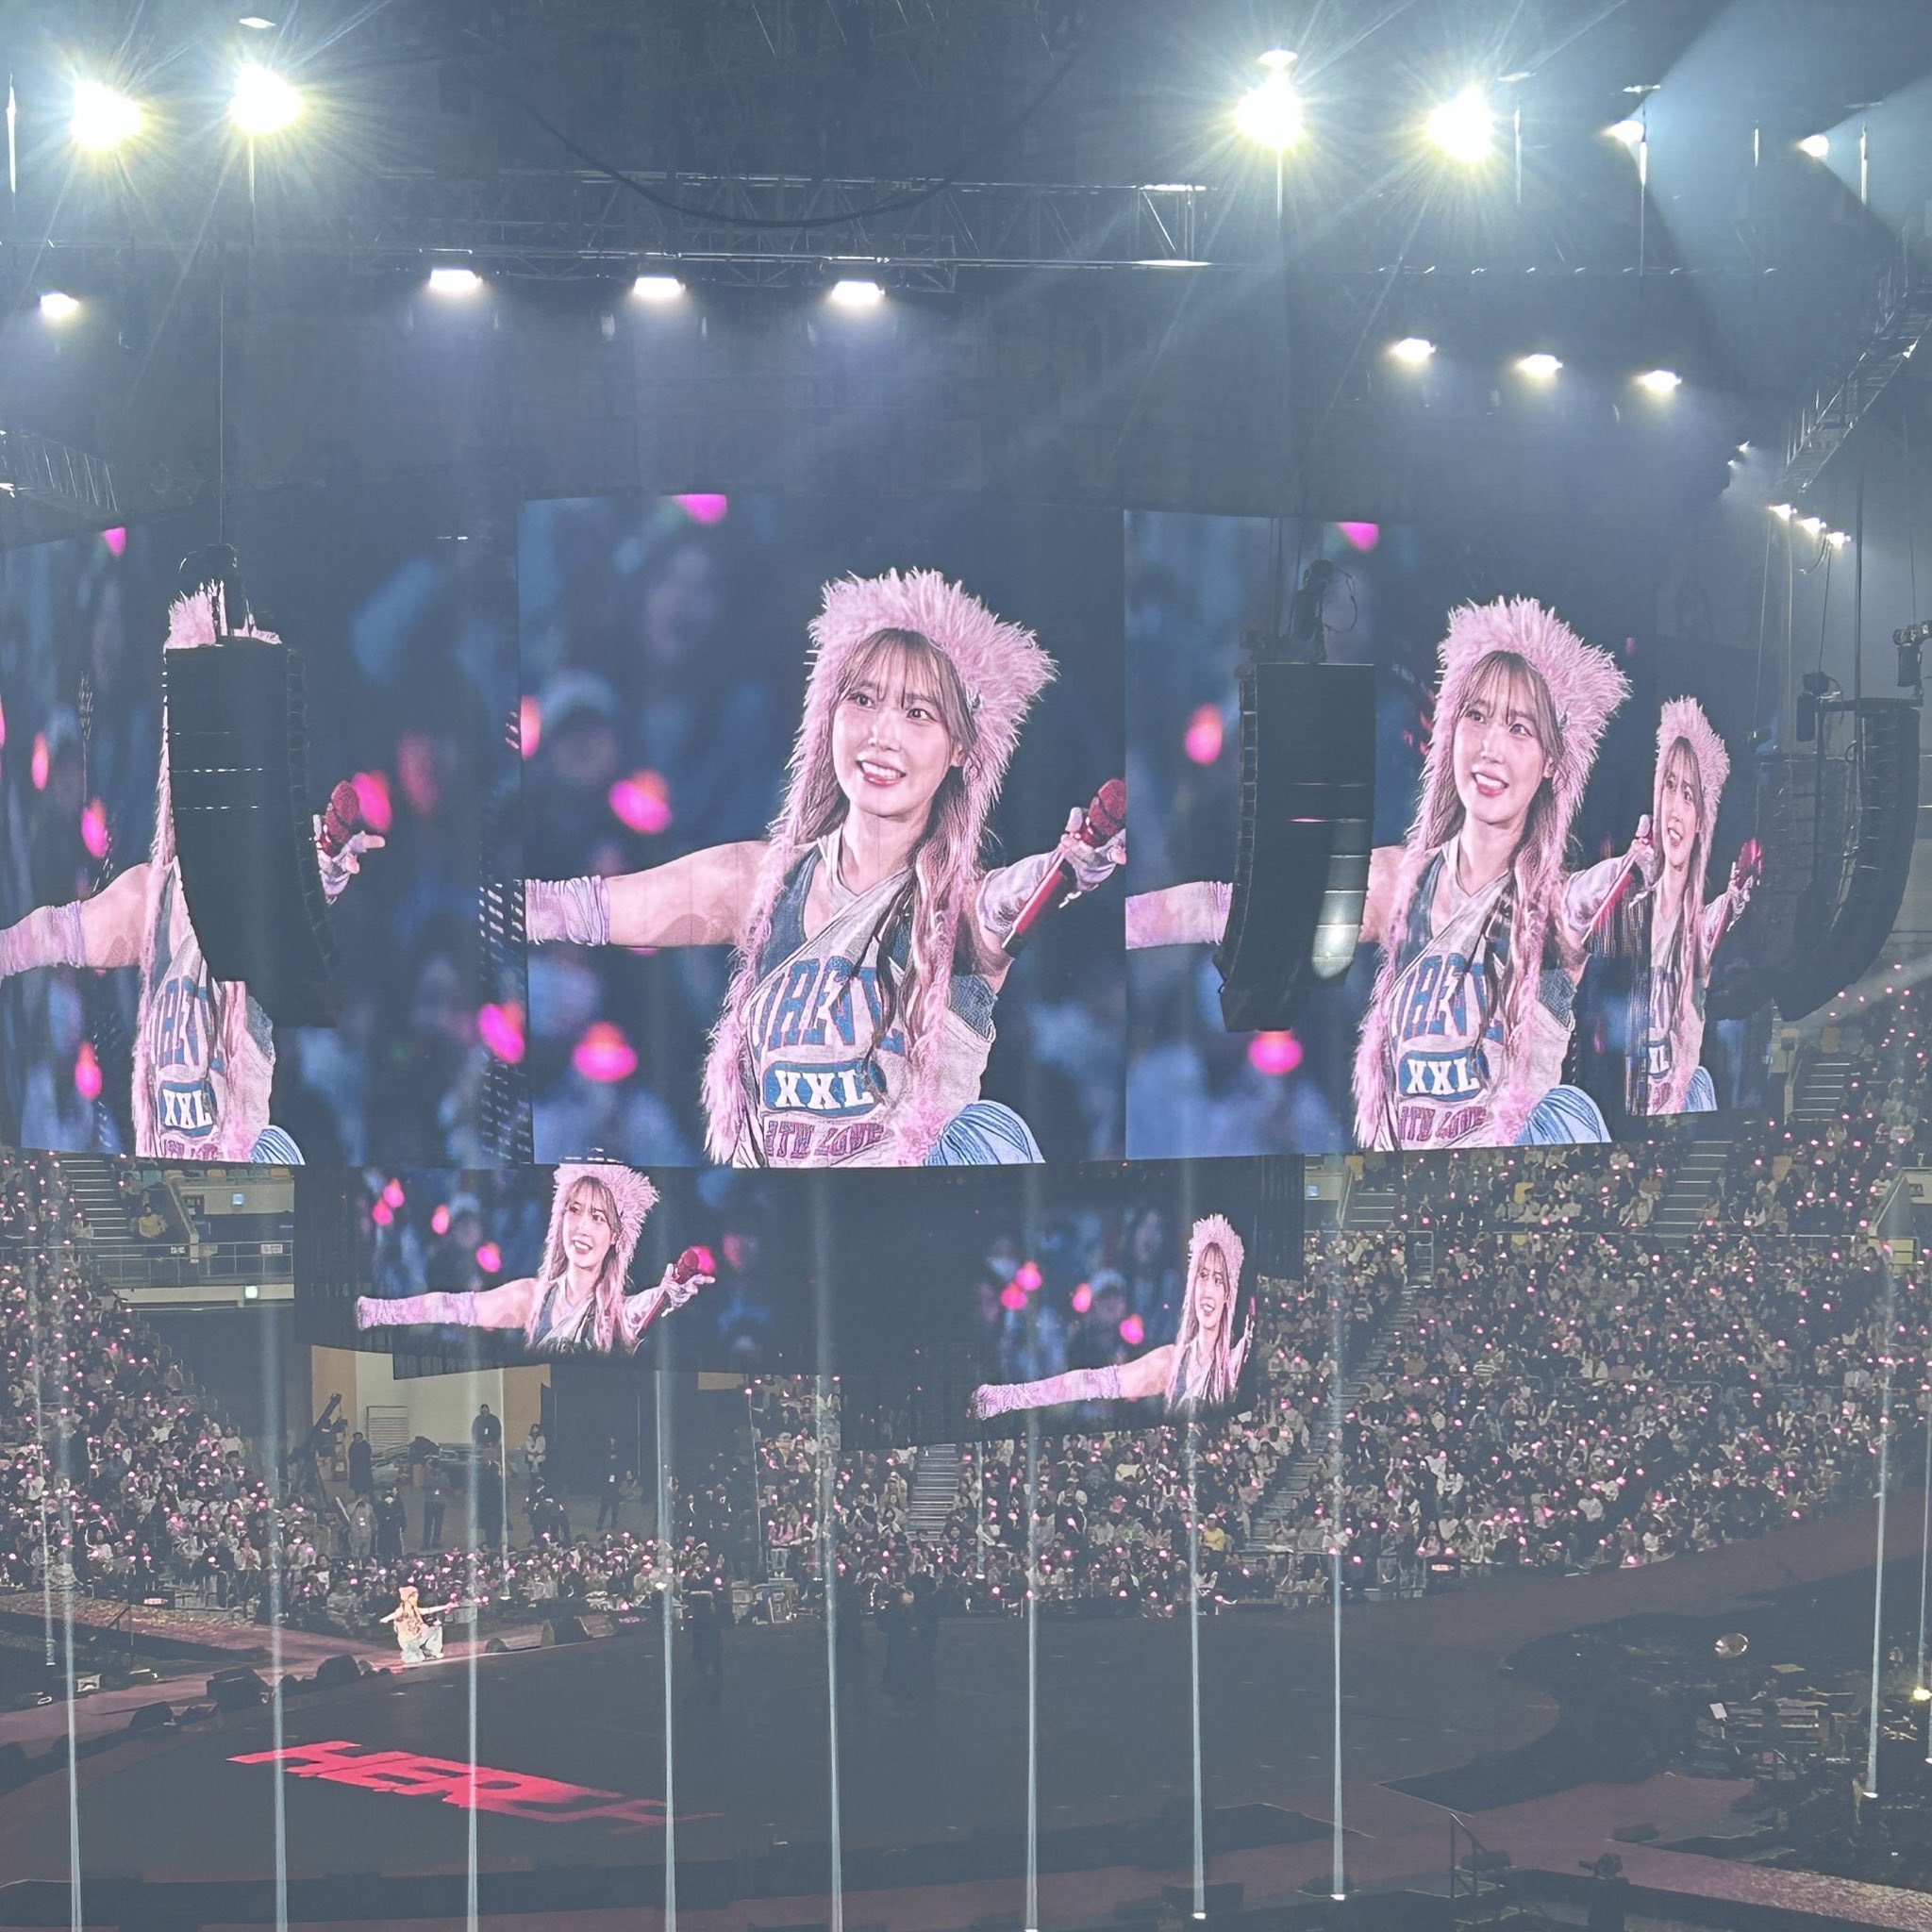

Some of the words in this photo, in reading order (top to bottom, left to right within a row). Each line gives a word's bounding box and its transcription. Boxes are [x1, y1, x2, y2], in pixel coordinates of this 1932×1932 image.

[774, 1069, 874, 1110] XXL
[1407, 1057, 1480, 1095] XXL
[162, 1088, 213, 1130] XXL
